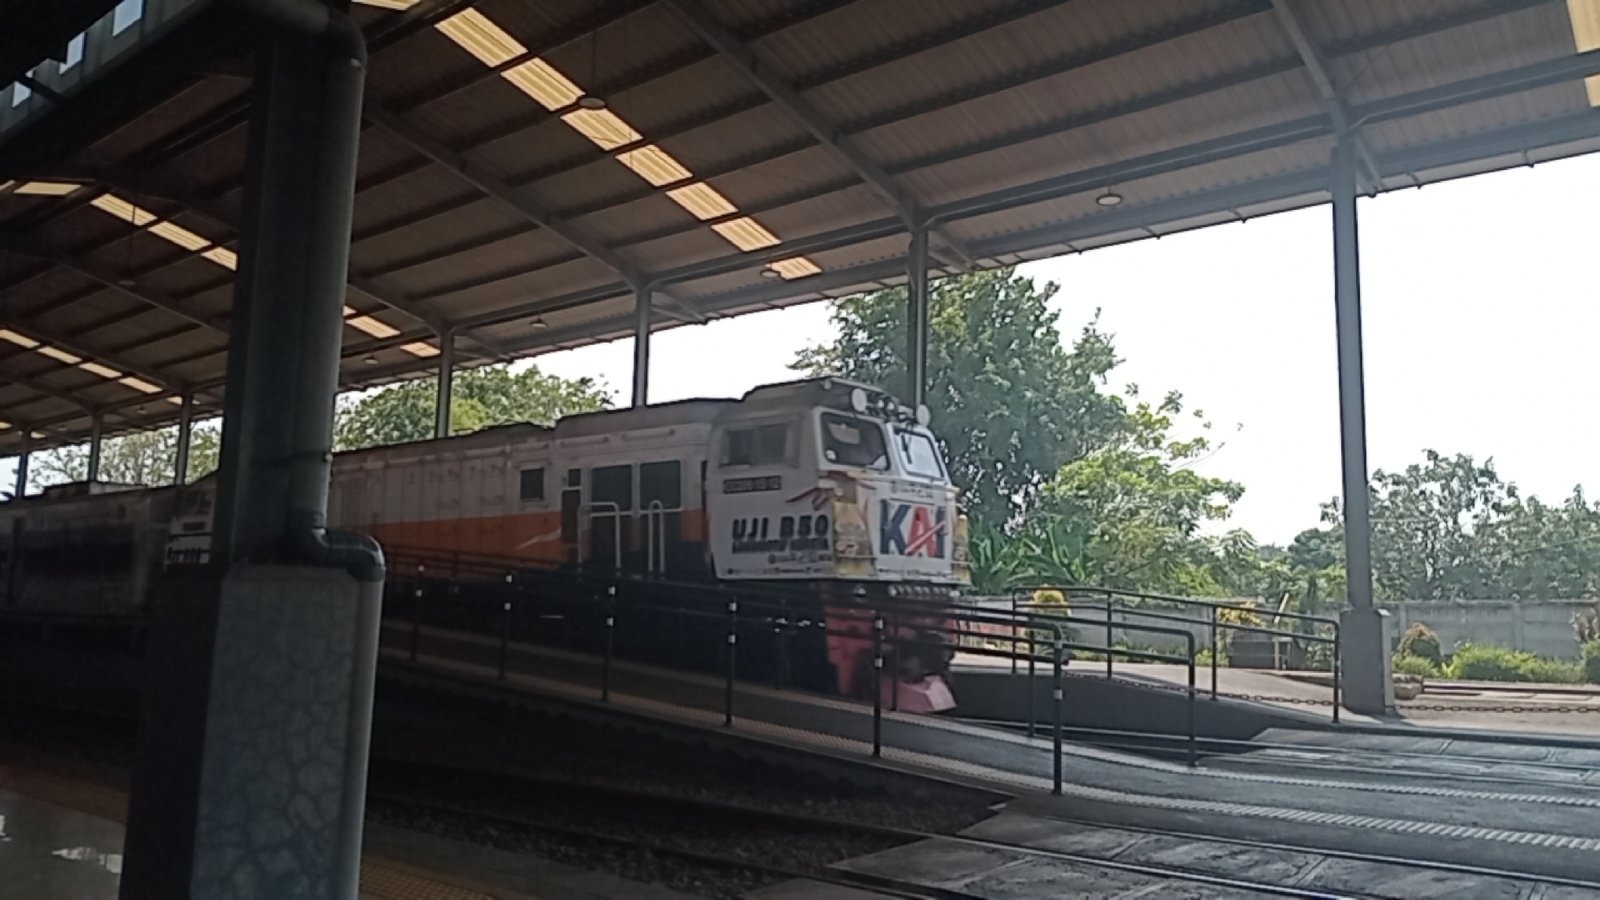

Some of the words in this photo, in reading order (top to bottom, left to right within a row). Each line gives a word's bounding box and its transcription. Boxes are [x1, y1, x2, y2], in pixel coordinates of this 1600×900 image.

[732, 518, 768, 539] UJI
[780, 514, 829, 537] B50
[879, 499, 946, 559] KAI
